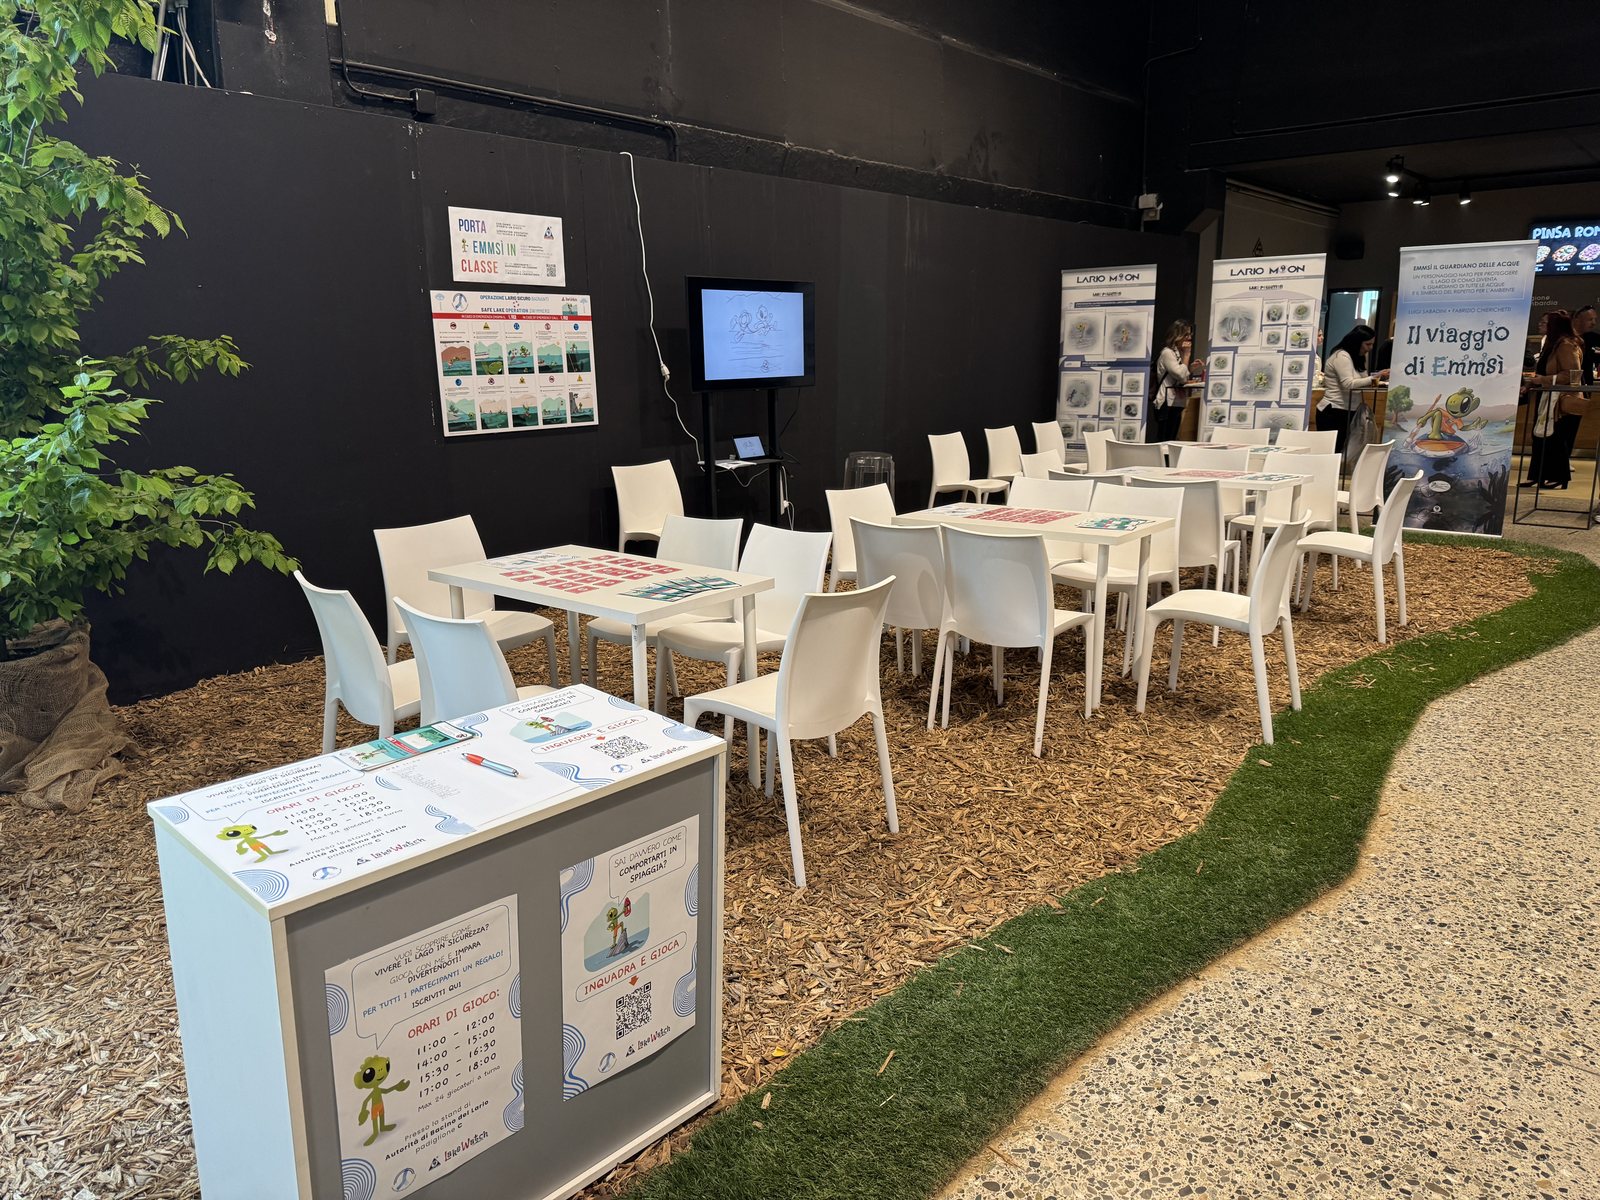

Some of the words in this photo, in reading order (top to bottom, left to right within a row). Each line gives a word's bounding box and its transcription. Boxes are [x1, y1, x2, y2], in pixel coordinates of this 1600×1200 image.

[459, 218, 487, 234] PORTA
[1532, 226, 1572, 240] PINSA
[473, 240, 504, 256] EMMSÌ
[508, 242, 516, 256] IN
[461, 258, 498, 274] CLASSE
[1076, 275, 1106, 284] LARIO
[1230, 267, 1264, 276] LARIO
[1407, 325, 1421, 344] Il
[1426, 321, 1510, 351] viaggio
[1404, 356, 1425, 376] di
[1431, 354, 1504, 376] Emmsì
[541, 732, 593, 752] INQUADRA
[608, 718, 639, 730] GIOCA
[266, 801, 302, 815] ORARI
[306, 795, 320, 803] DI
[324, 782, 365, 797] GIOCO:
[284, 807, 316, 820] 11:00
[337, 791, 368, 804] 12:00
[290, 812, 324, 825] 14:00
[345, 795, 376, 808] 15:00
[300, 816, 332, 829] 15:30
[353, 800, 383, 813] 16:30
[305, 822, 338, 836] 17:00
[359, 805, 391, 818] 18:00
[289, 850, 327, 867] Autorità
[306, 843, 335, 856] Presso
[347, 831, 372, 841] stand
[327, 842, 373, 860] padiglione
[614, 856, 626, 868] SAI
[629, 841, 661, 862] DAVVERO
[663, 832, 682, 847] COME
[619, 850, 667, 877] COMPORTARTI
[669, 844, 678, 854] IN
[630, 860, 667, 883] SPIAGGIA?
[374, 960, 402, 977] VIVERE
[404, 955, 412, 965] IL
[415, 948, 434, 960] LAGO
[436, 942, 445, 952] IN
[448, 924, 489, 947] SICUREZZA?
[394, 949, 412, 962] VUOI
[415, 935, 449, 954] SCOPRIRE
[452, 924, 471, 938] COME
[389, 970, 413, 984] GIOCA
[416, 962, 428, 973] CON
[434, 956, 446, 966] ME
[455, 941, 481, 957] IMPARA
[407, 955, 462, 984] DIVERTENDOTI!
[584, 962, 636, 996] INQUADRA
[640, 956, 646, 967] E
[650, 939, 680, 961] GIOCA
[363, 1006, 377, 1018] PER
[379, 995, 400, 1010] TUTTI
[410, 969, 460, 996] PARTECIPANTI
[463, 963, 473, 973] UN
[475, 950, 504, 966] REGALO!
[411, 989, 446, 1009] ISCRIVITI
[448, 981, 462, 992] QUI
[408, 1016, 441, 1039] ORARI
[446, 1008, 458, 1022] DI
[462, 989, 500, 1013] GIOCO:
[417, 1036, 446, 1055] 11:00
[466, 1012, 495, 1032] 12:00
[417, 1050, 448, 1070] 14:00
[468, 1026, 495, 1045] 15:00
[419, 1077, 448, 1098] 17:00
[468, 1052, 497, 1072] 18:00
[420, 1063, 449, 1083] 15:30
[469, 1039, 496, 1058] 16:30
[418, 1103, 432, 1112] Max
[447, 1078, 474, 1099] giocatori
[483, 1065, 500, 1077] turno
[385, 1139, 419, 1161] Autorità
[420, 1132, 429, 1141] di
[430, 1119, 456, 1136] Bacino
[458, 1110, 470, 1121] del
[470, 1100, 489, 1113] Lario
[404, 1124, 430, 1141] Presso
[441, 1106, 462, 1122] stand
[464, 1100, 471, 1109] di
[415, 1128, 456, 1155] padiglione
[444, 1130, 489, 1162] LakeWatch
